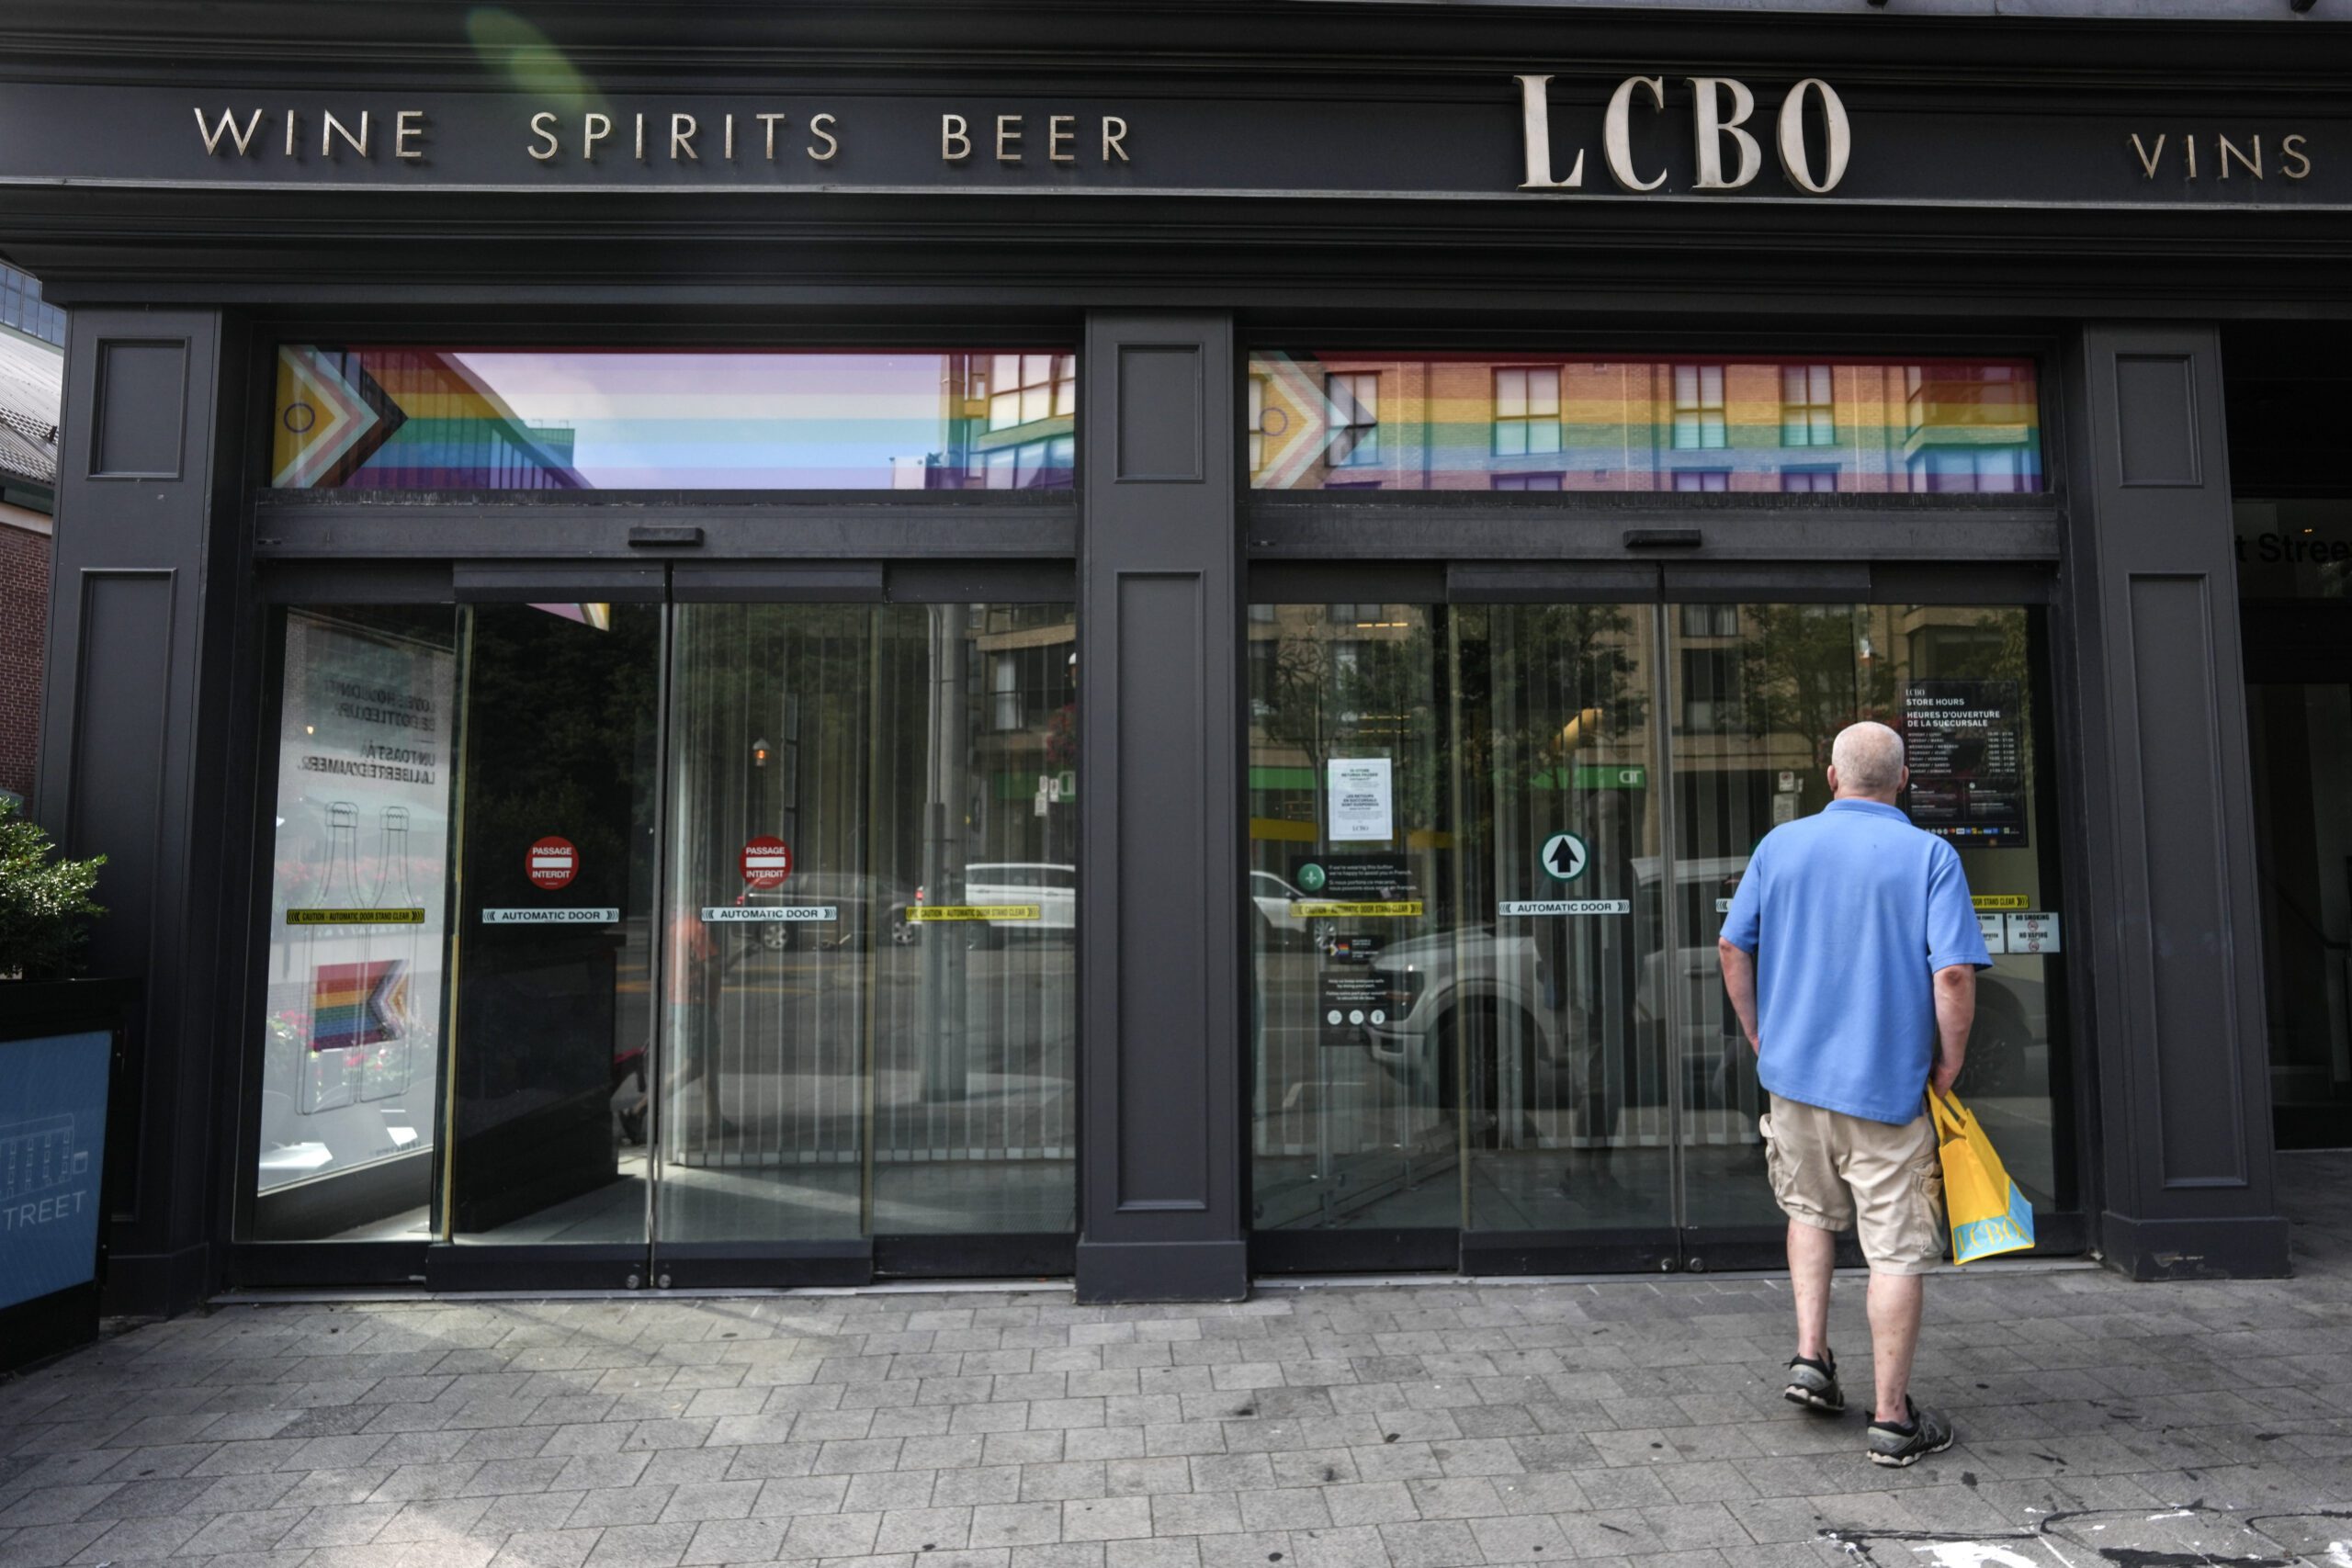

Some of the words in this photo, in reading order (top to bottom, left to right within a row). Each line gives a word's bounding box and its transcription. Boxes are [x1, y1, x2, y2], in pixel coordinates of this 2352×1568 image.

[193, 106, 424, 158] WINE
[526, 111, 839, 161] SPIRITS
[942, 114, 1130, 161] BEER
[1512, 74, 1851, 195] LCBO
[2131, 133, 2312, 180] VINS
[2258, 533, 2352, 563] Stree
[1906, 711, 1941, 719] HEURES
[1942, 710, 2000, 718] D'OUVERTURE
[1907, 719, 1919, 728] DE
[1920, 719, 1931, 728] LA
[532, 847, 572, 855] PASSAGE
[745, 846, 786, 855] PASSAGE
[532, 870, 571, 879] INTERDIT
[746, 870, 785, 878] INTERDIT
[1984, 897, 1998, 905] STAND
[2000, 897, 2015, 905] CLEAR
[1517, 903, 1578, 912] AUTOMATIC
[1580, 902, 1611, 911] DOOR
[302, 912, 325, 921] CAUTION
[329, 911, 358, 921] AUTOMATIC
[359, 911, 374, 920] DOOR
[375, 911, 392, 920] STAND
[392, 910, 410, 920] CLEAR
[502, 911, 566, 920] AUTOMATIC
[568, 910, 600, 919] DOOR
[720, 909, 783, 919] AUTOMATIC
[786, 909, 818, 918] DOOR
[2, 1190, 87, 1231] TREET
